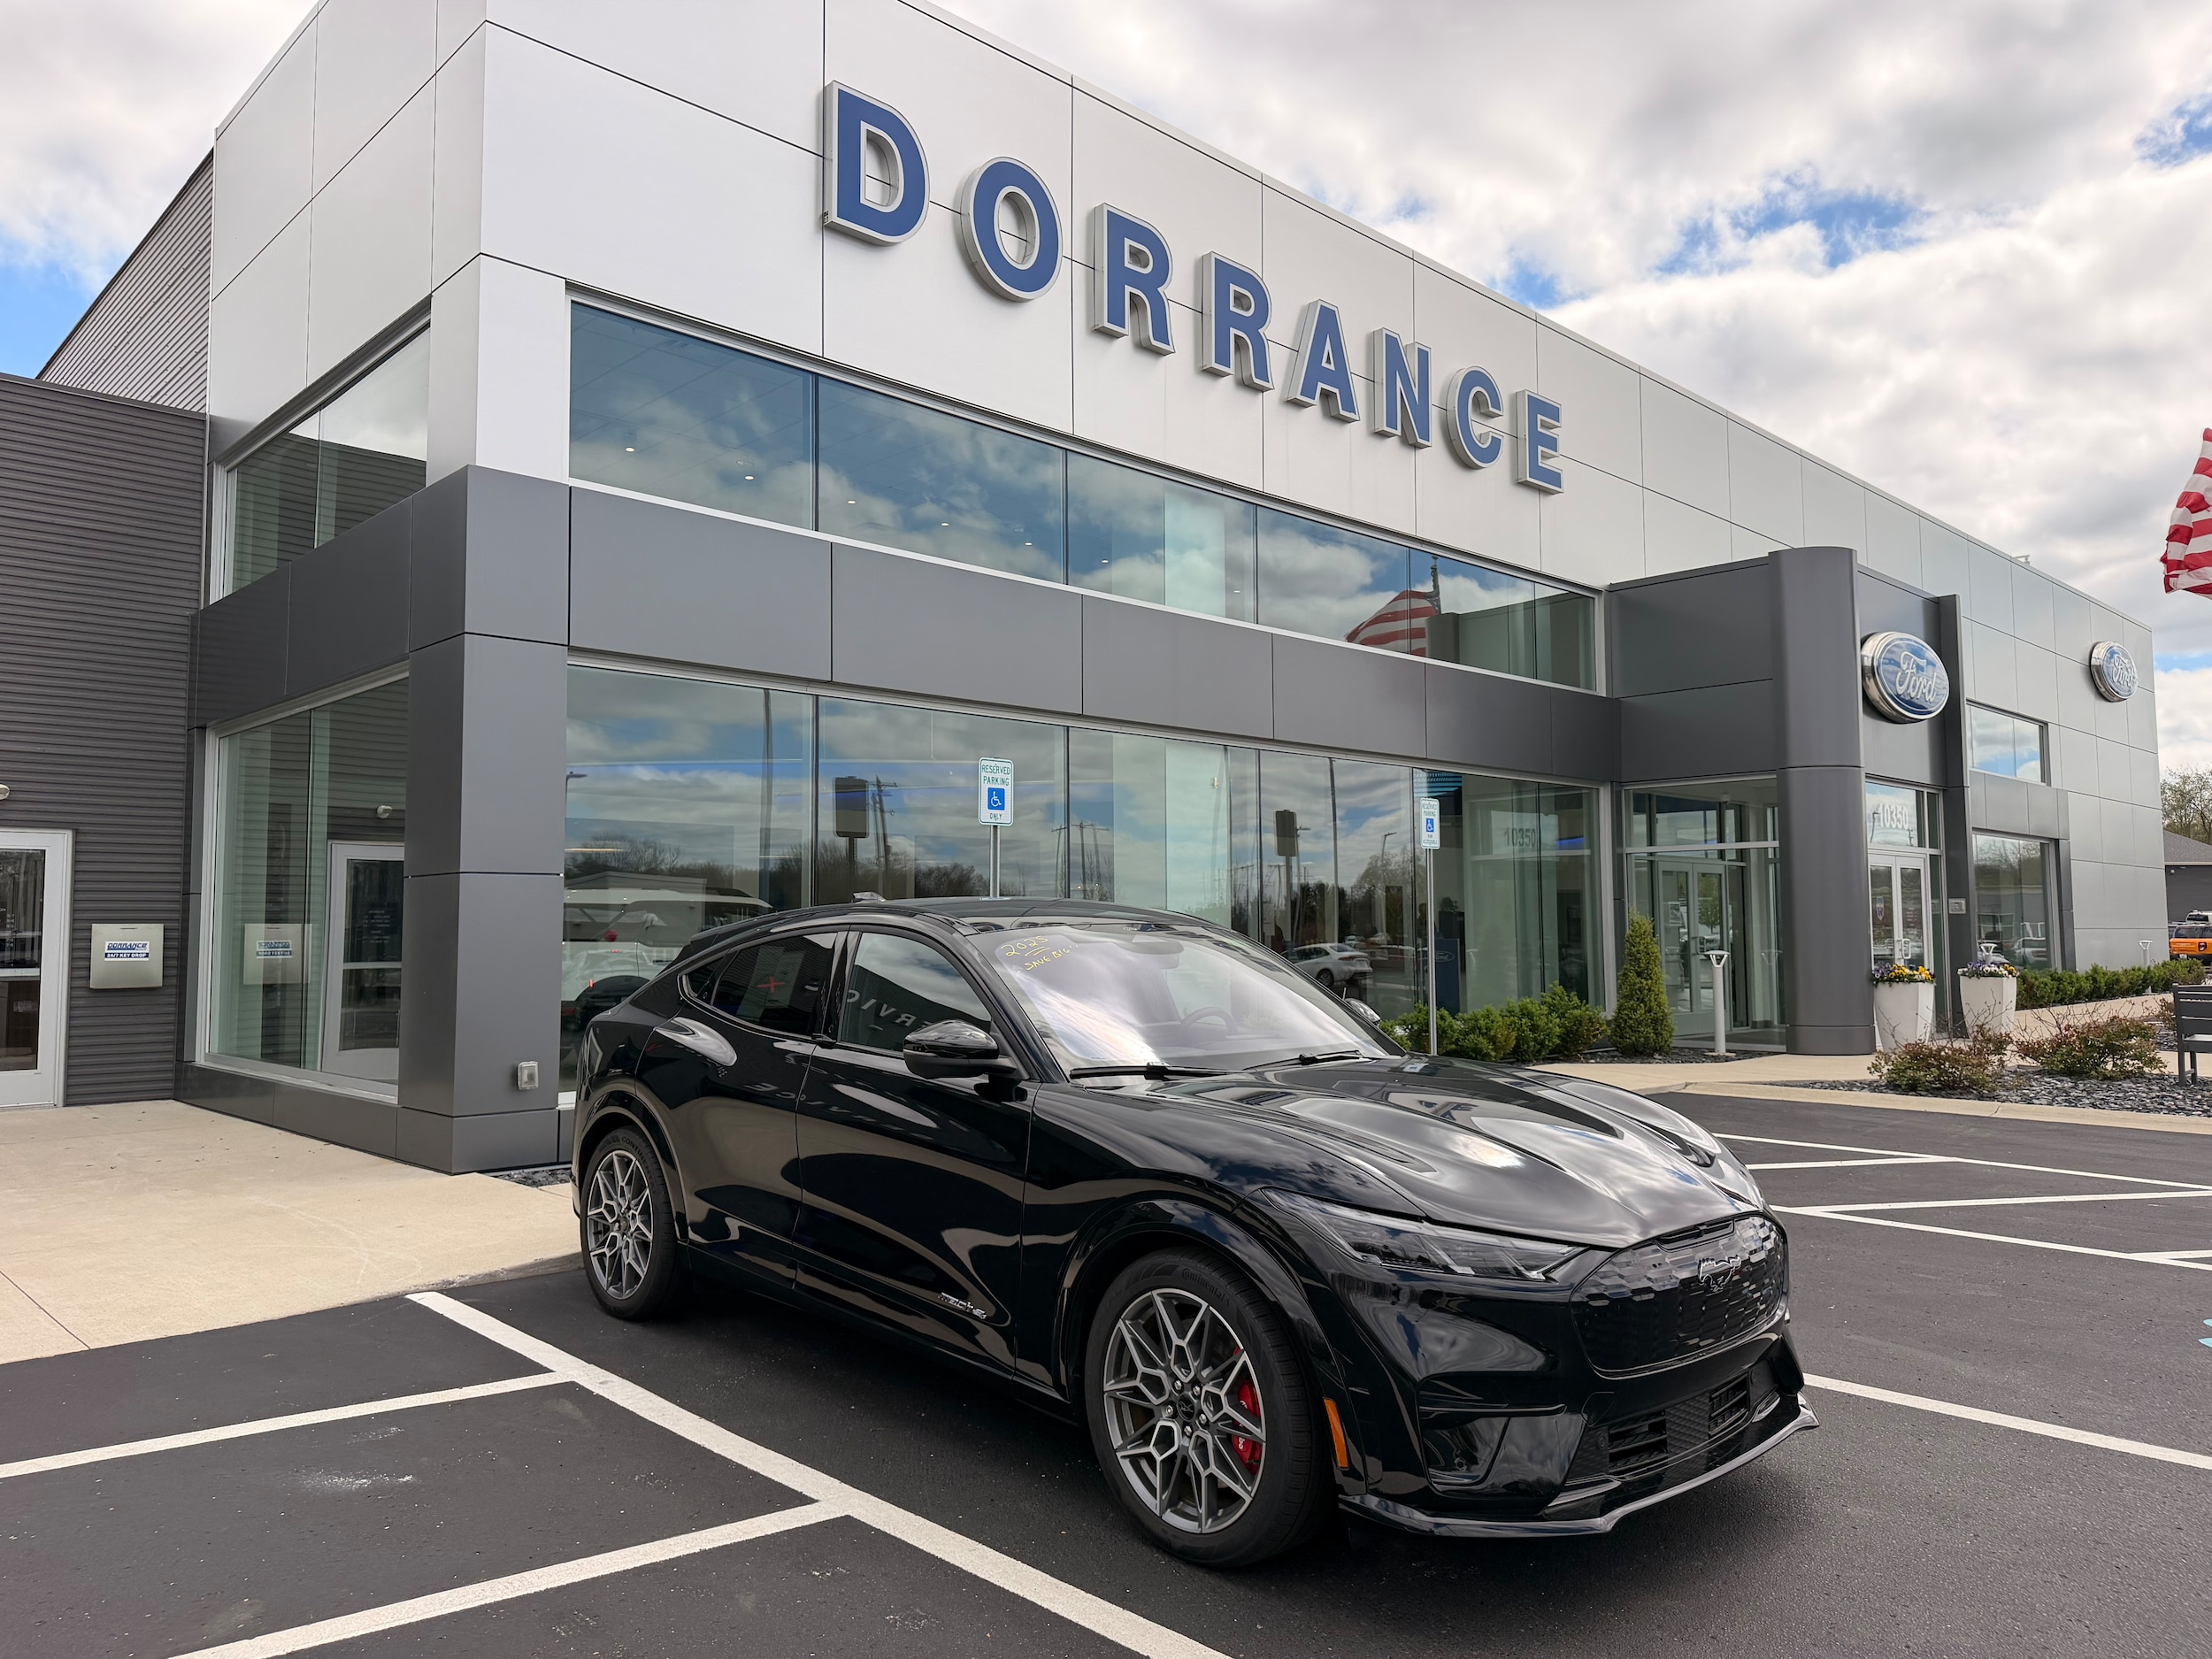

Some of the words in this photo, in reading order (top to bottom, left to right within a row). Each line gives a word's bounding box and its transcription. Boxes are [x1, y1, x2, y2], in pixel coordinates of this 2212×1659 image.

[824, 80, 1563, 493] DORRANCE
[1896, 651, 1936, 703] Ford
[2113, 654, 2131, 688] Ford
[982, 764, 1011, 775] RESERVED
[983, 776, 1010, 786] PARKING
[1878, 803, 1909, 829] 10350
[1504, 827, 1536, 848] 10350
[1001, 935, 1048, 956] 2025
[1182, 1268, 1226, 1302] Continental
